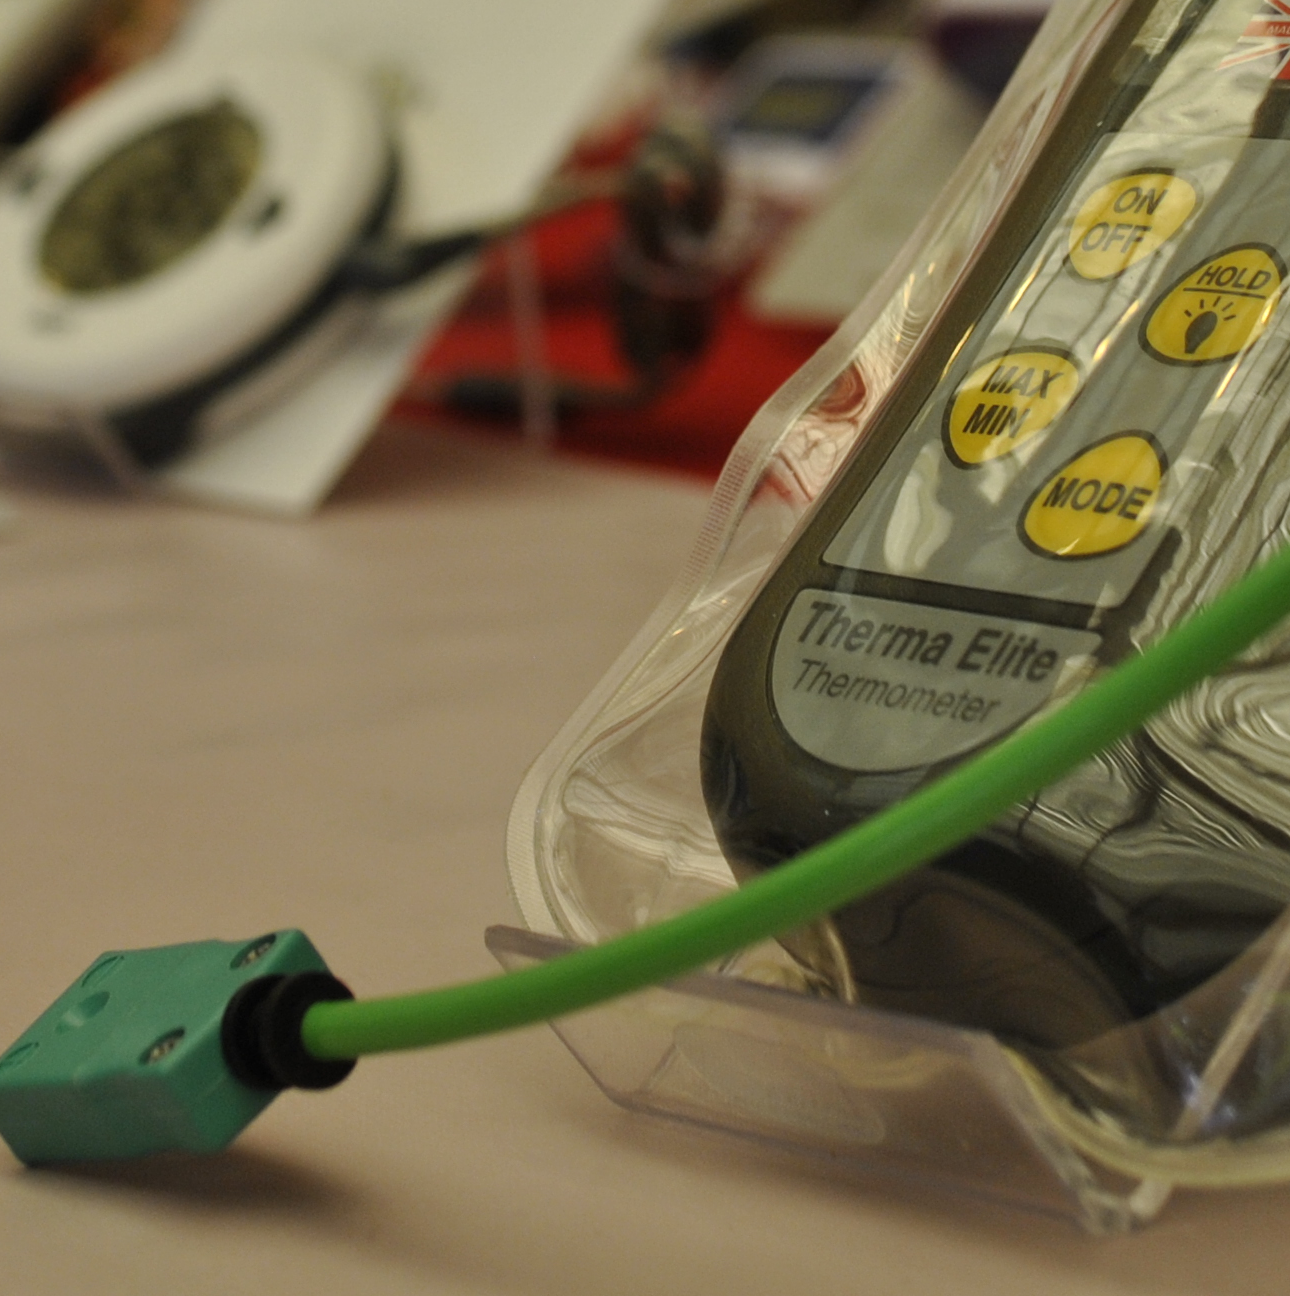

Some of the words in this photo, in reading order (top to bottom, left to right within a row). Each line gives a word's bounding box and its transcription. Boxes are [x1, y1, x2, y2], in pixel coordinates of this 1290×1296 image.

[1113, 187, 1169, 215] ON
[1080, 222, 1151, 254] OFF
[1198, 264, 1272, 291] HOLD
[980, 365, 1063, 400] MAX
[962, 403, 1031, 440] MIN
[1042, 477, 1153, 521] MODE
[797, 601, 951, 665] Therma
[958, 628, 1060, 682] Elite
[791, 658, 1003, 724] Thermometer
